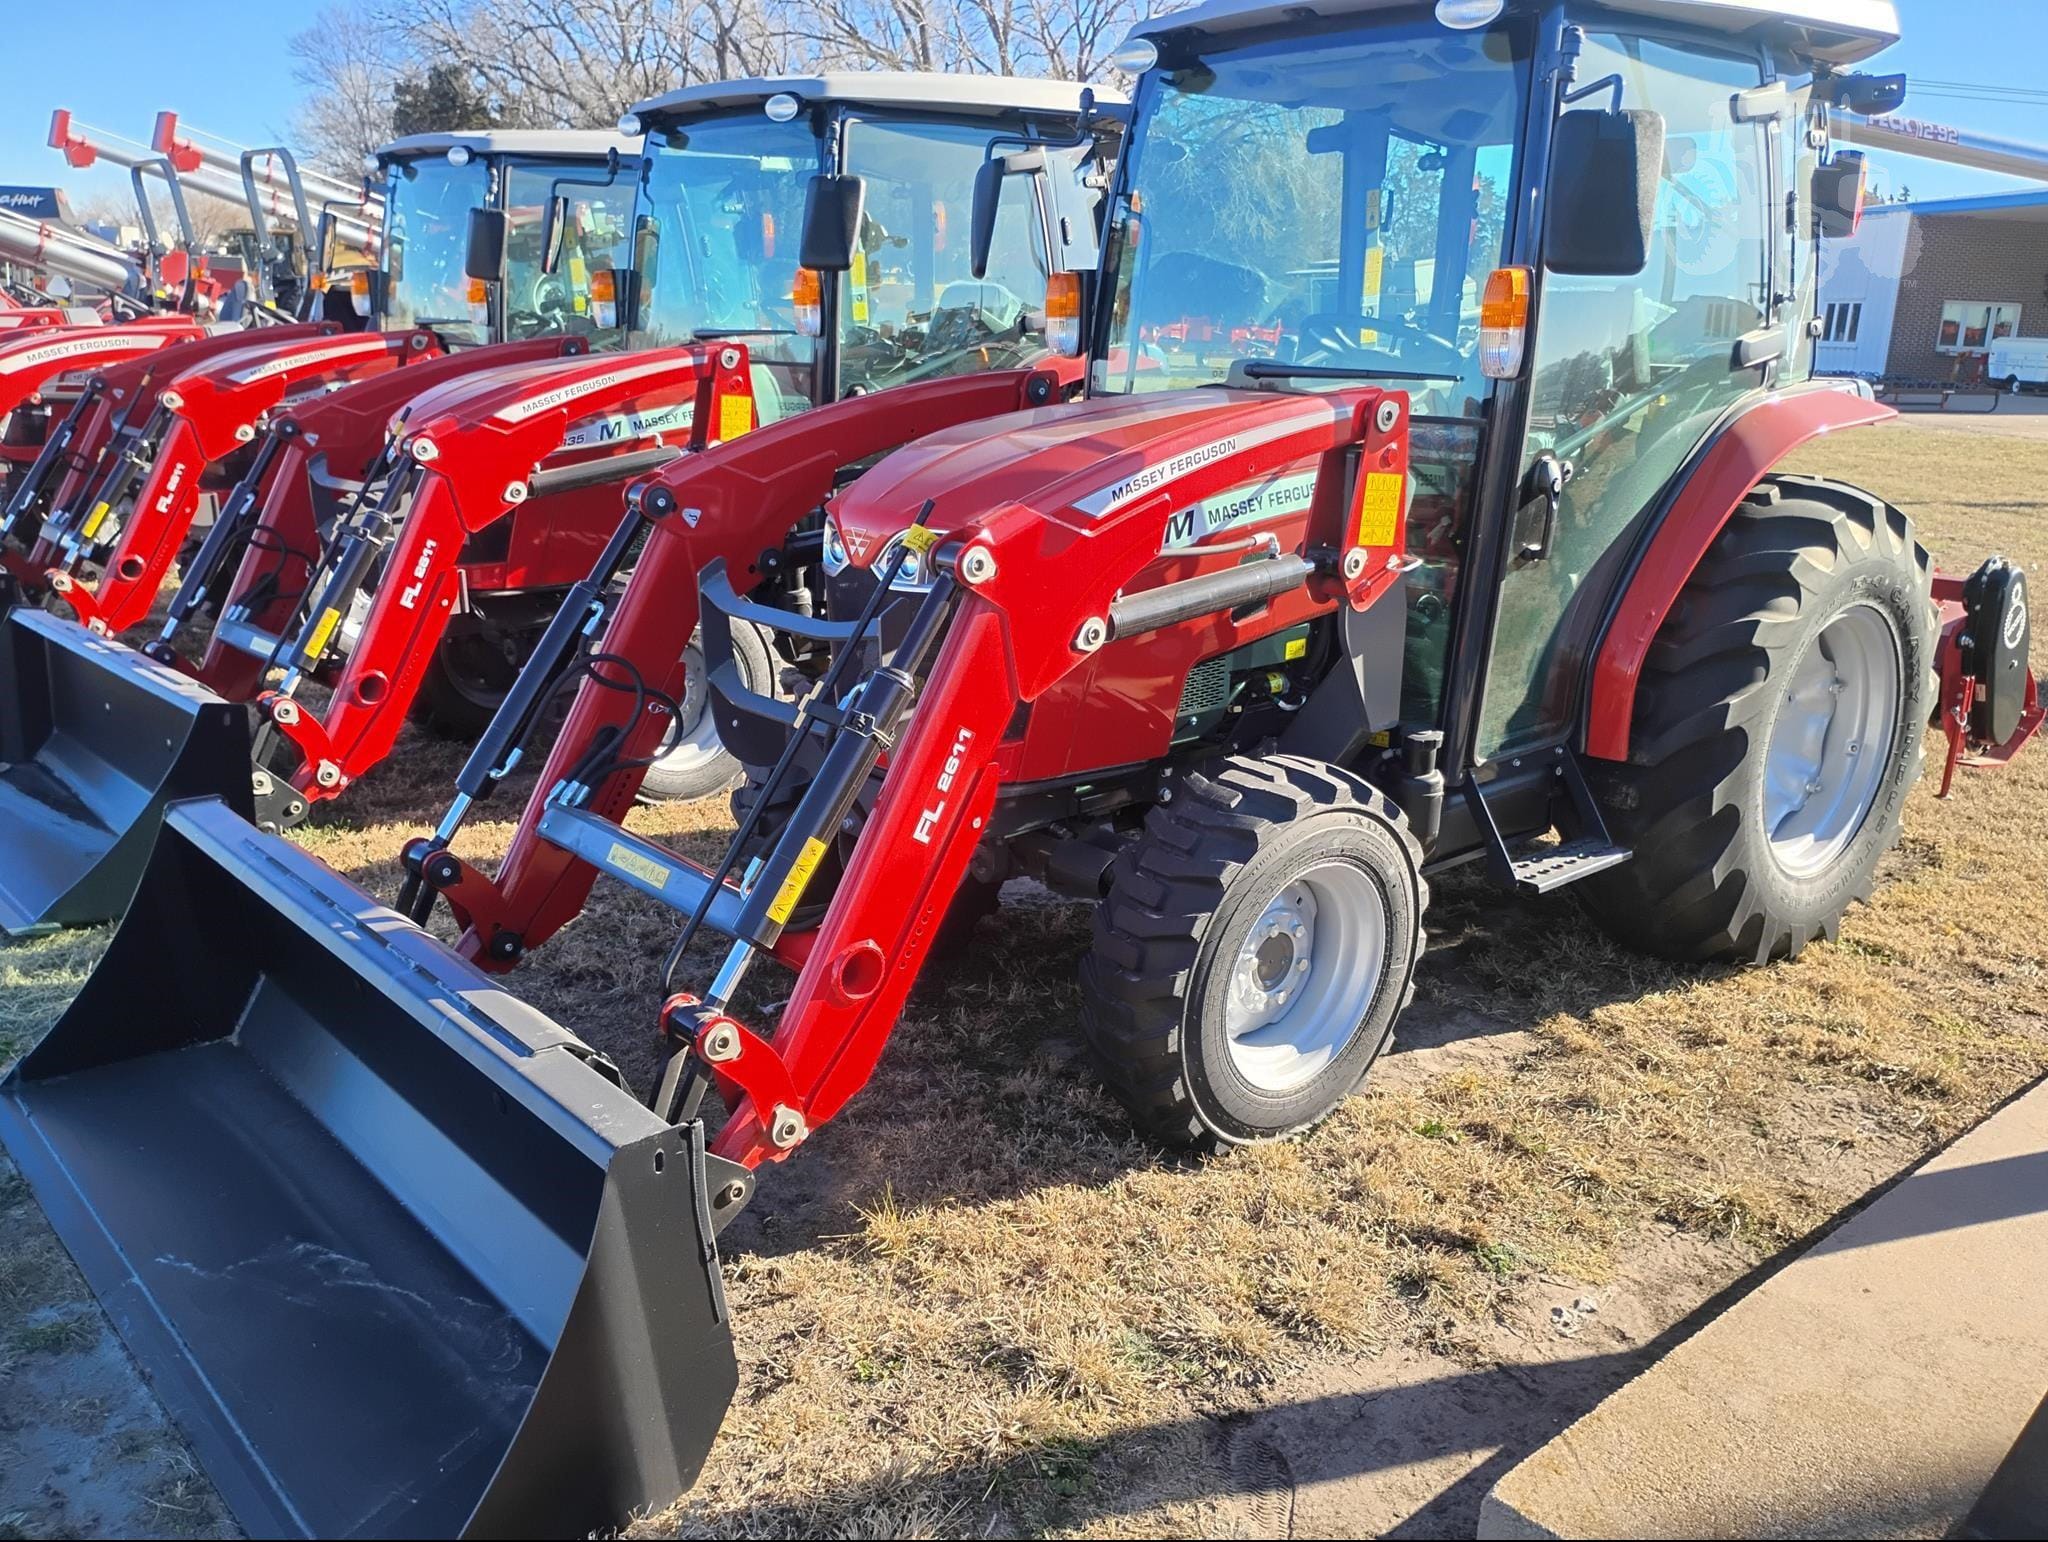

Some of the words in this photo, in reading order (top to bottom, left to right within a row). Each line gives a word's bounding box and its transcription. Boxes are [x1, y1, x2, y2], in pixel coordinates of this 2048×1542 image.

[27, 345, 70, 363] MASSEY
[73, 338, 130, 352] FERGUSON
[522, 392, 562, 413] MASSEY
[564, 375, 616, 399] FERGUSON
[600, 421, 622, 441] M
[633, 412, 679, 432] MASSEY
[1111, 466, 1166, 502] MASSEY
[1169, 438, 1237, 476] FERGUSON
[1208, 495, 1263, 525] MASSEY
[1164, 509, 1195, 544] M
[400, 583, 422, 609] FL
[912, 800, 945, 845] FL
[937, 728, 972, 793] 2611
